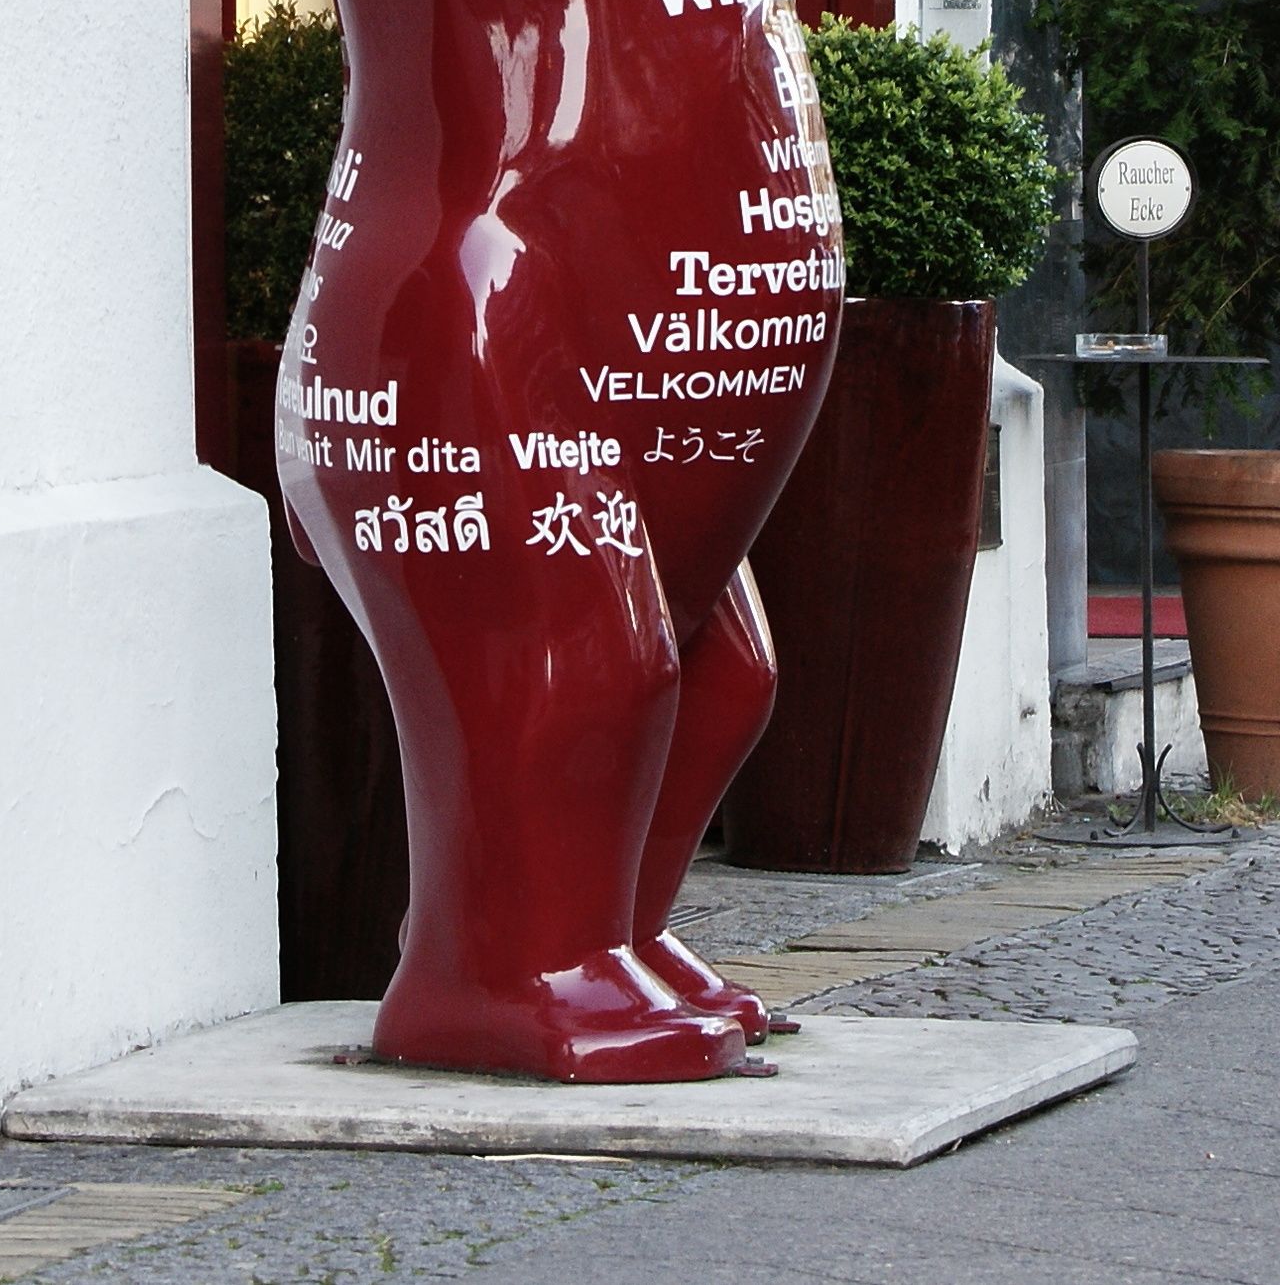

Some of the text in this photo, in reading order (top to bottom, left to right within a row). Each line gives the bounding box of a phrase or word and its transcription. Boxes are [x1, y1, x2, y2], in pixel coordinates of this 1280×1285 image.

[1119, 160, 1175, 185] Raucher
[1129, 196, 1163, 221] Ecke
[627, 309, 826, 353] Välkomna
[580, 364, 806, 402] VELKOMMEN
[345, 437, 396, 472] Mir
[407, 437, 481, 473] dita
[508, 431, 621, 475] Vitejte
[643, 427, 765, 464] ようこそ
[354, 491, 491, 553] สวัสดี
[525, 490, 644, 557] 欢迎
